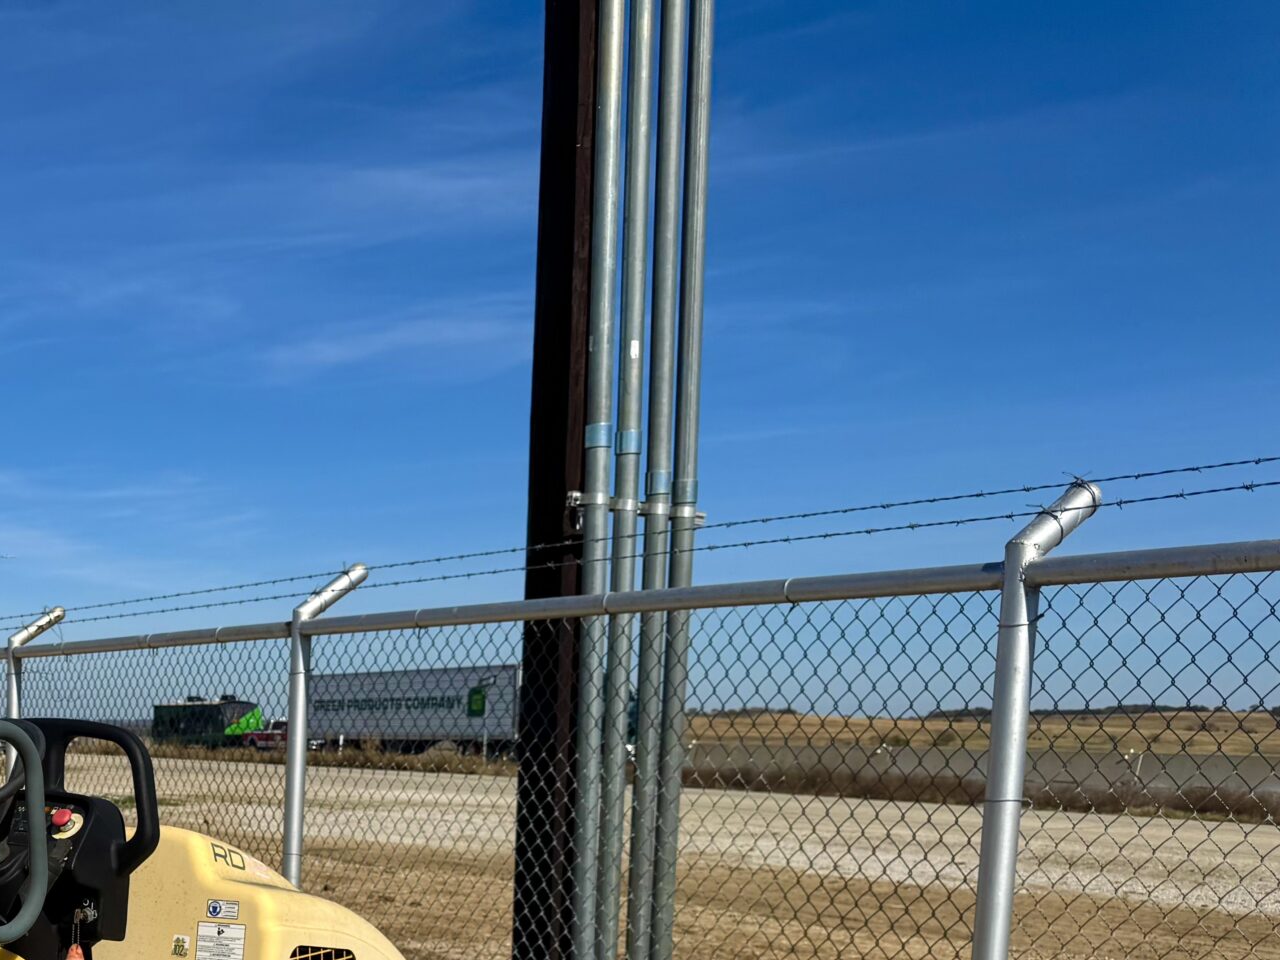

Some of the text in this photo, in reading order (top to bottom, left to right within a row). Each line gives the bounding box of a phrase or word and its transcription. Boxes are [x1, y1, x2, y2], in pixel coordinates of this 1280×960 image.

[313, 695, 463, 712] GREEN PRODUCTS COMPANY
[210, 842, 246, 871] RD
